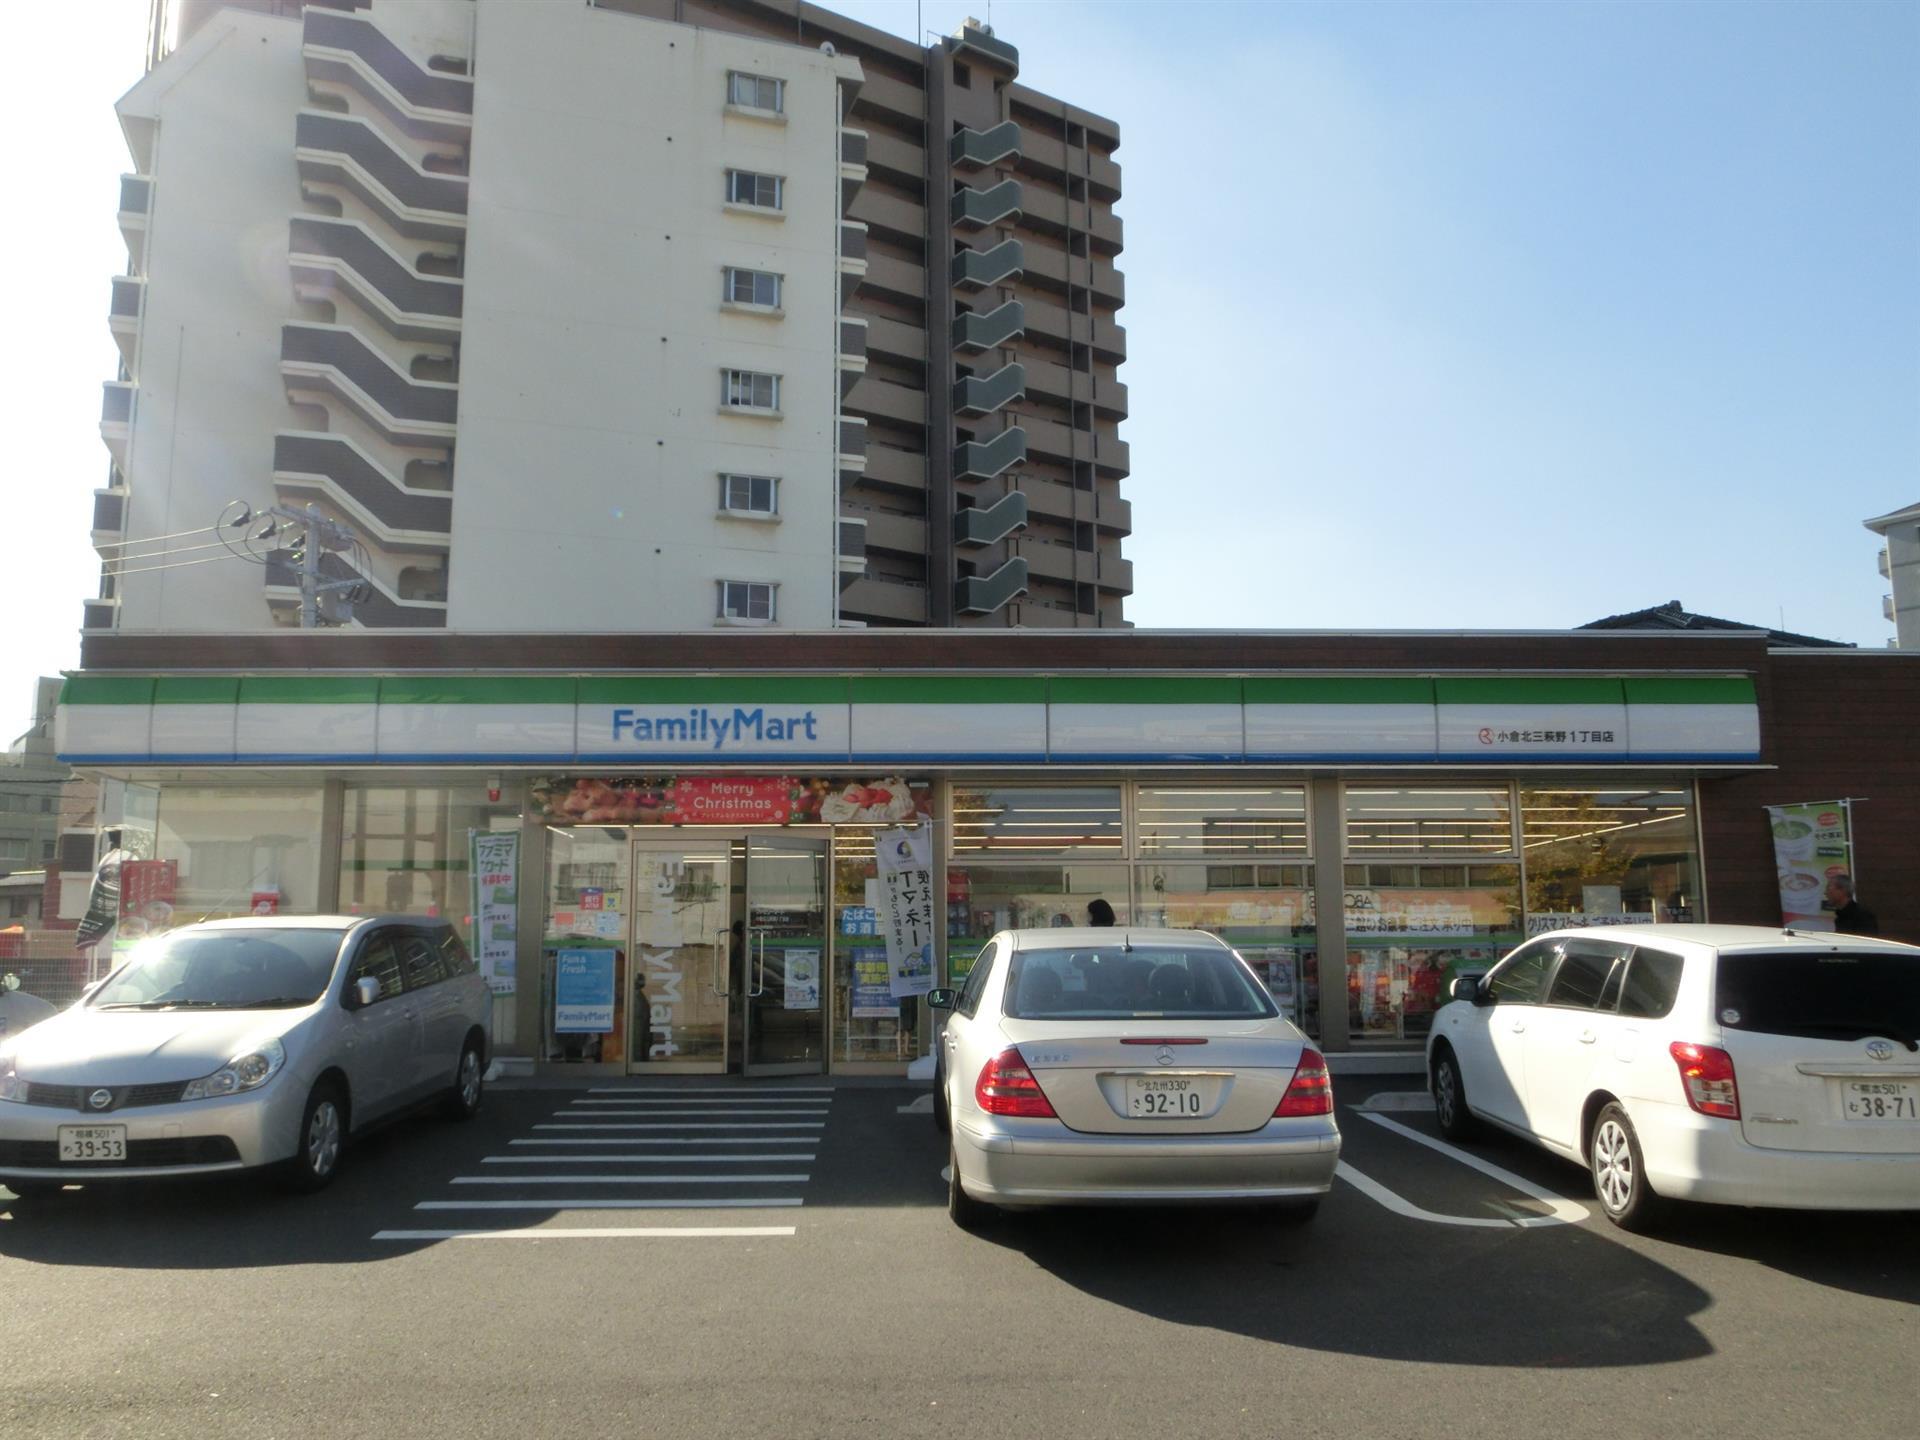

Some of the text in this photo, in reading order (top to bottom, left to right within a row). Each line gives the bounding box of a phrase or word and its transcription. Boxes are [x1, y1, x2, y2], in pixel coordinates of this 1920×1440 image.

[612, 708, 818, 749] FamilyMart
[711, 782, 754, 796] Merry
[694, 796, 772, 809] Christmas
[842, 909, 875, 921] たばこ
[846, 922, 873, 934] お酒
[558, 1011, 611, 1022] FamilyMart
[1144, 1093, 1200, 1113] 92-10
[1860, 1096, 1916, 1118] 38-71
[74, 1140, 122, 1157] 39-53
